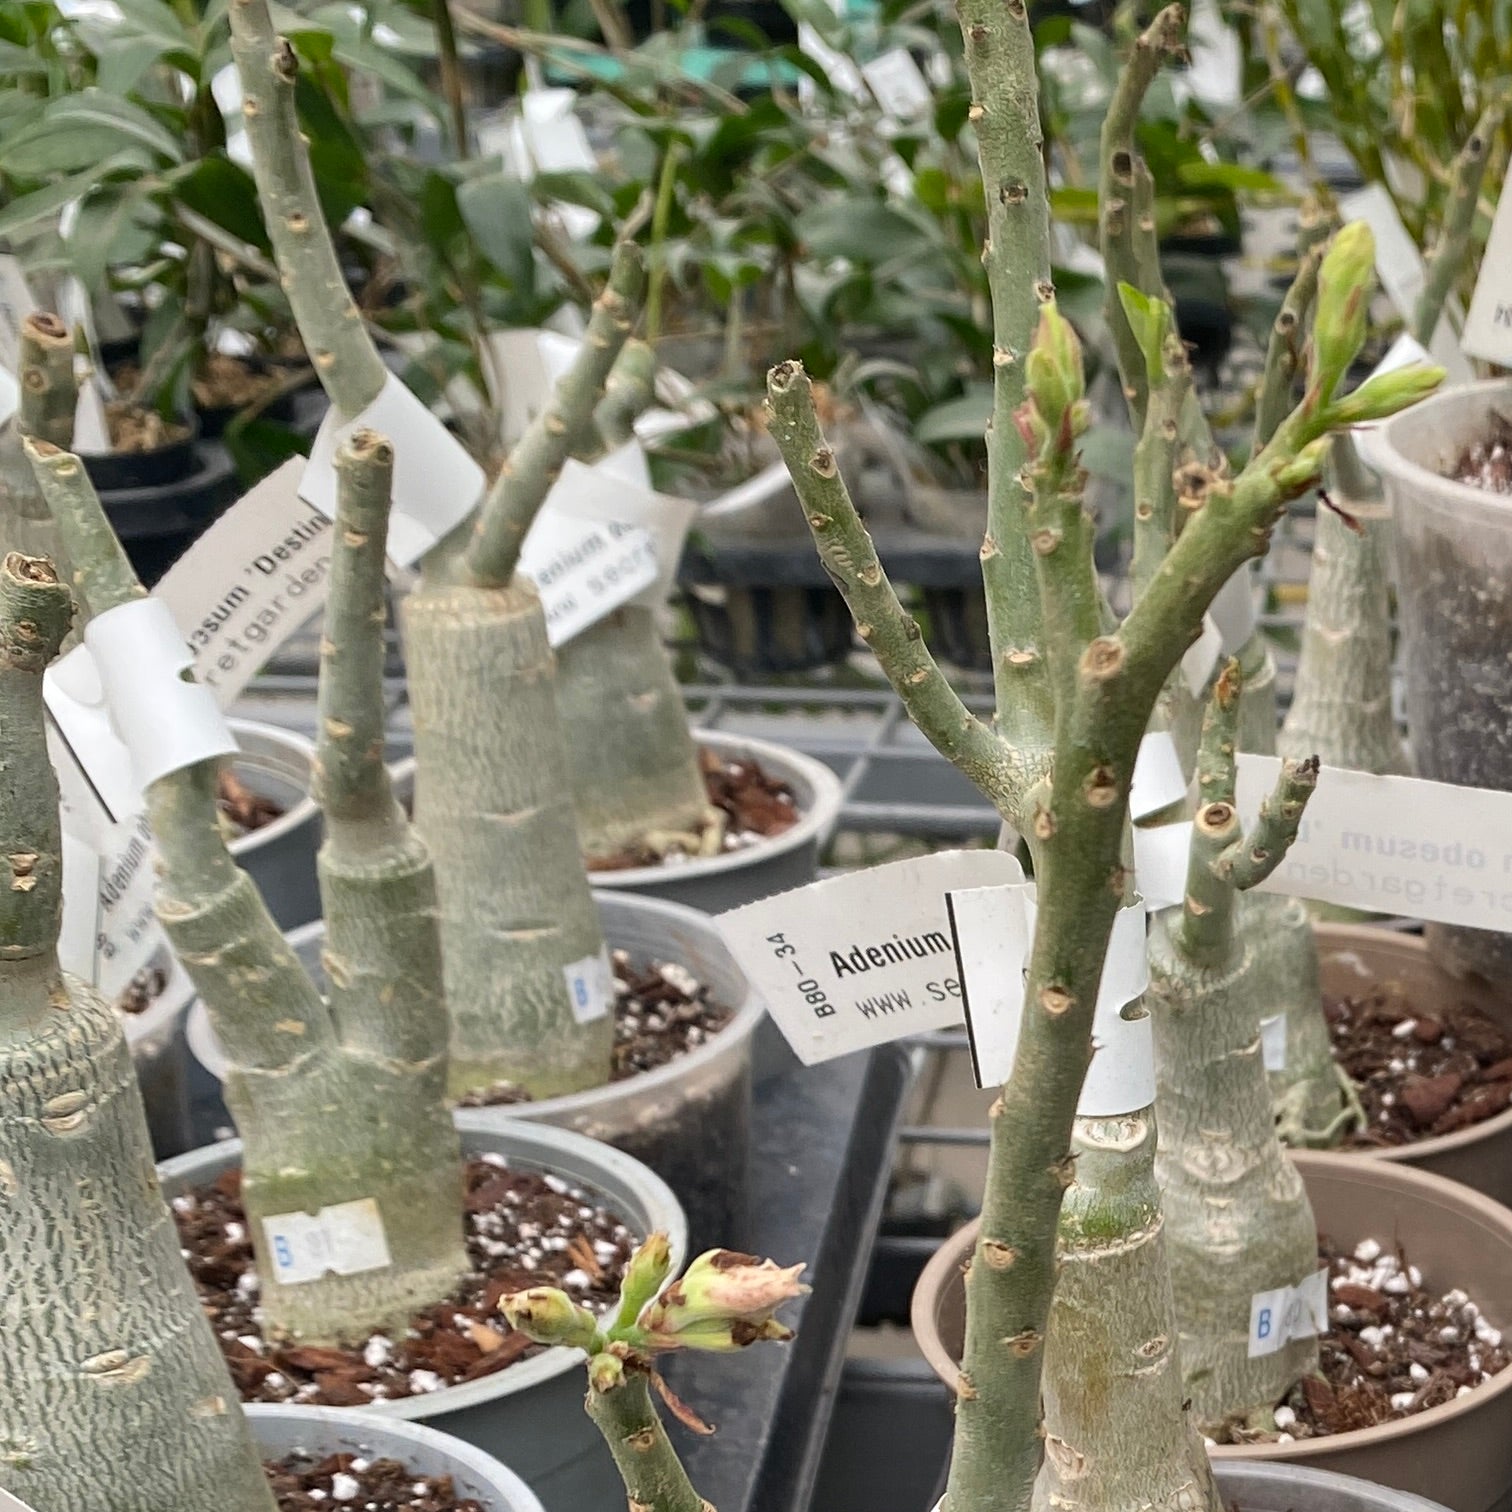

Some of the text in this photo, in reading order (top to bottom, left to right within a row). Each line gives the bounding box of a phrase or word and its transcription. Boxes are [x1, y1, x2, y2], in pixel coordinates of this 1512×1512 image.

[766, 932, 836, 1019] B80-34
[828, 928, 953, 979] Adenium
[1257, 1308, 1272, 1339] B
